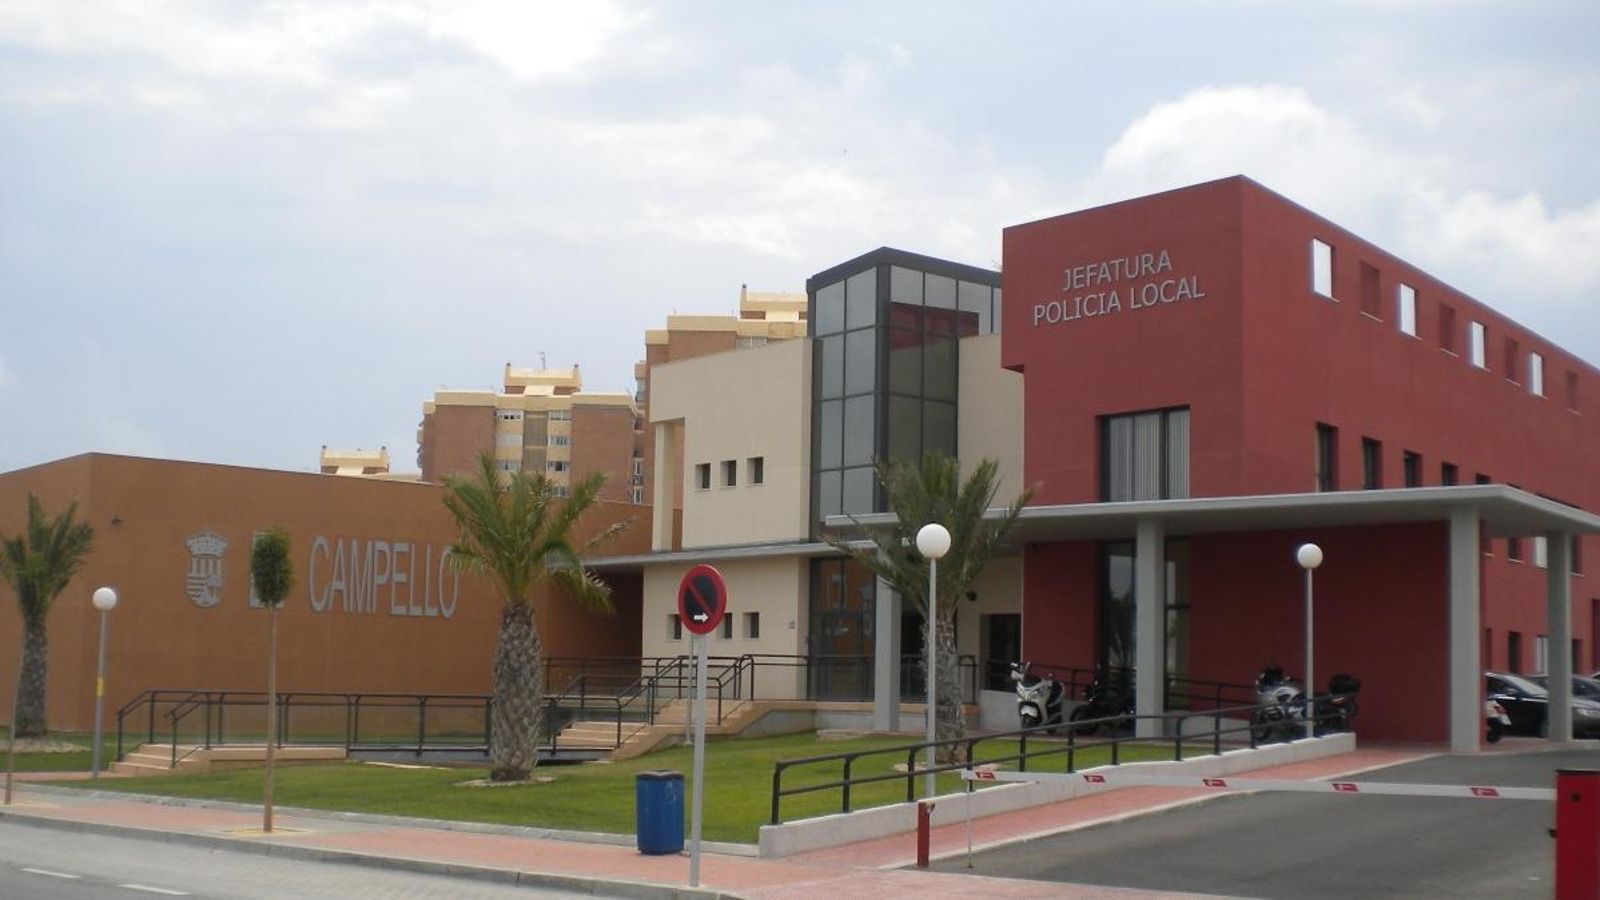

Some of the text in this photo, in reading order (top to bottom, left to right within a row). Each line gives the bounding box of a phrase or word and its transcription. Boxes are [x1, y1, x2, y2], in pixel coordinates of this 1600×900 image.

[1062, 250, 1173, 292] JEFATURA
[1034, 276, 1206, 326] POLICIA LOCAL
[309, 535, 459, 618] CAMPELLO
